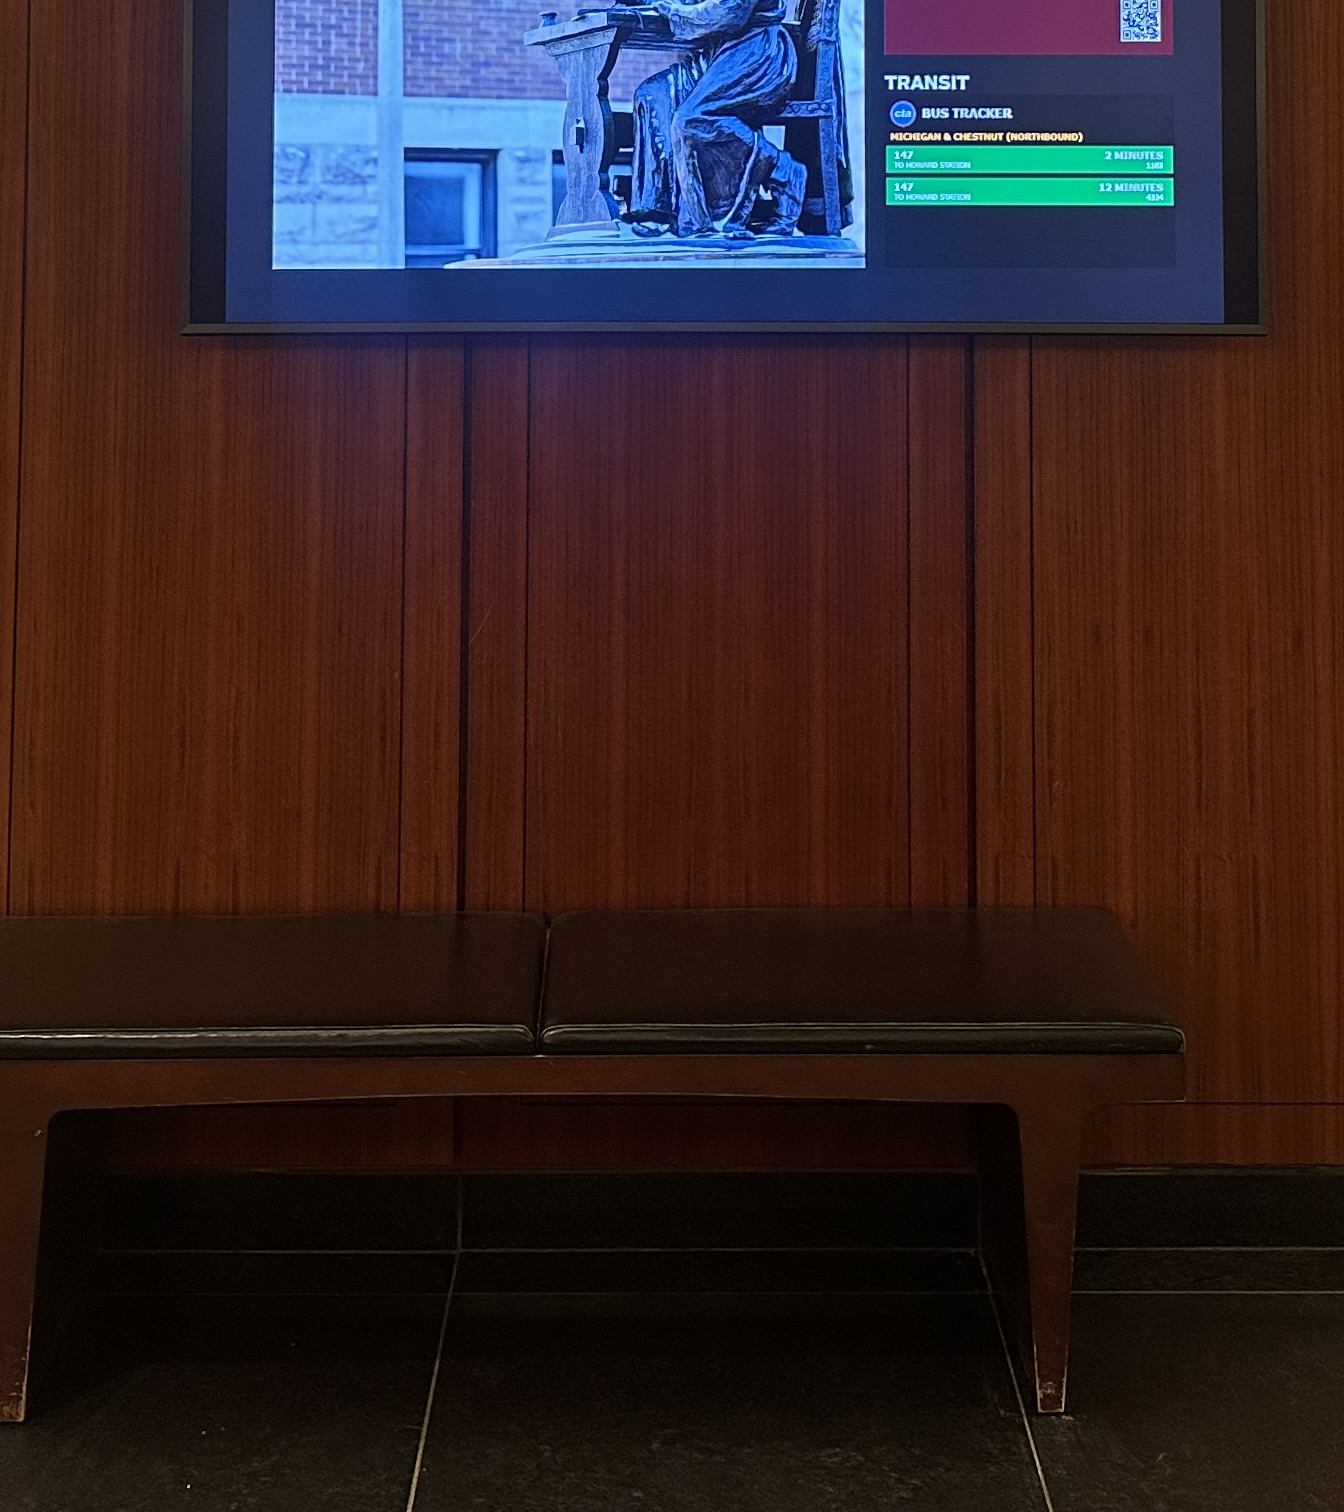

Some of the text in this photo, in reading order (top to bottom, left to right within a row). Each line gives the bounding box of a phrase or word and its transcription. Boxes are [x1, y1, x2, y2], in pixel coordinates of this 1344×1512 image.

[884, 74, 970, 91] TRANSIT
[894, 109, 913, 118] cta
[921, 107, 1014, 119] BUS TRACKER
[890, 132, 1084, 143] MICHIGAN & CHESTNUT (NORTHBOUND)
[893, 150, 914, 160] 147
[1104, 150, 1164, 160] 2 MINUTES
[894, 161, 971, 169] TO HOWARD STATION
[893, 182, 914, 192] 147
[1099, 182, 1164, 192] 12 MINUTES
[894, 193, 972, 201] TO HOWARD STATION
